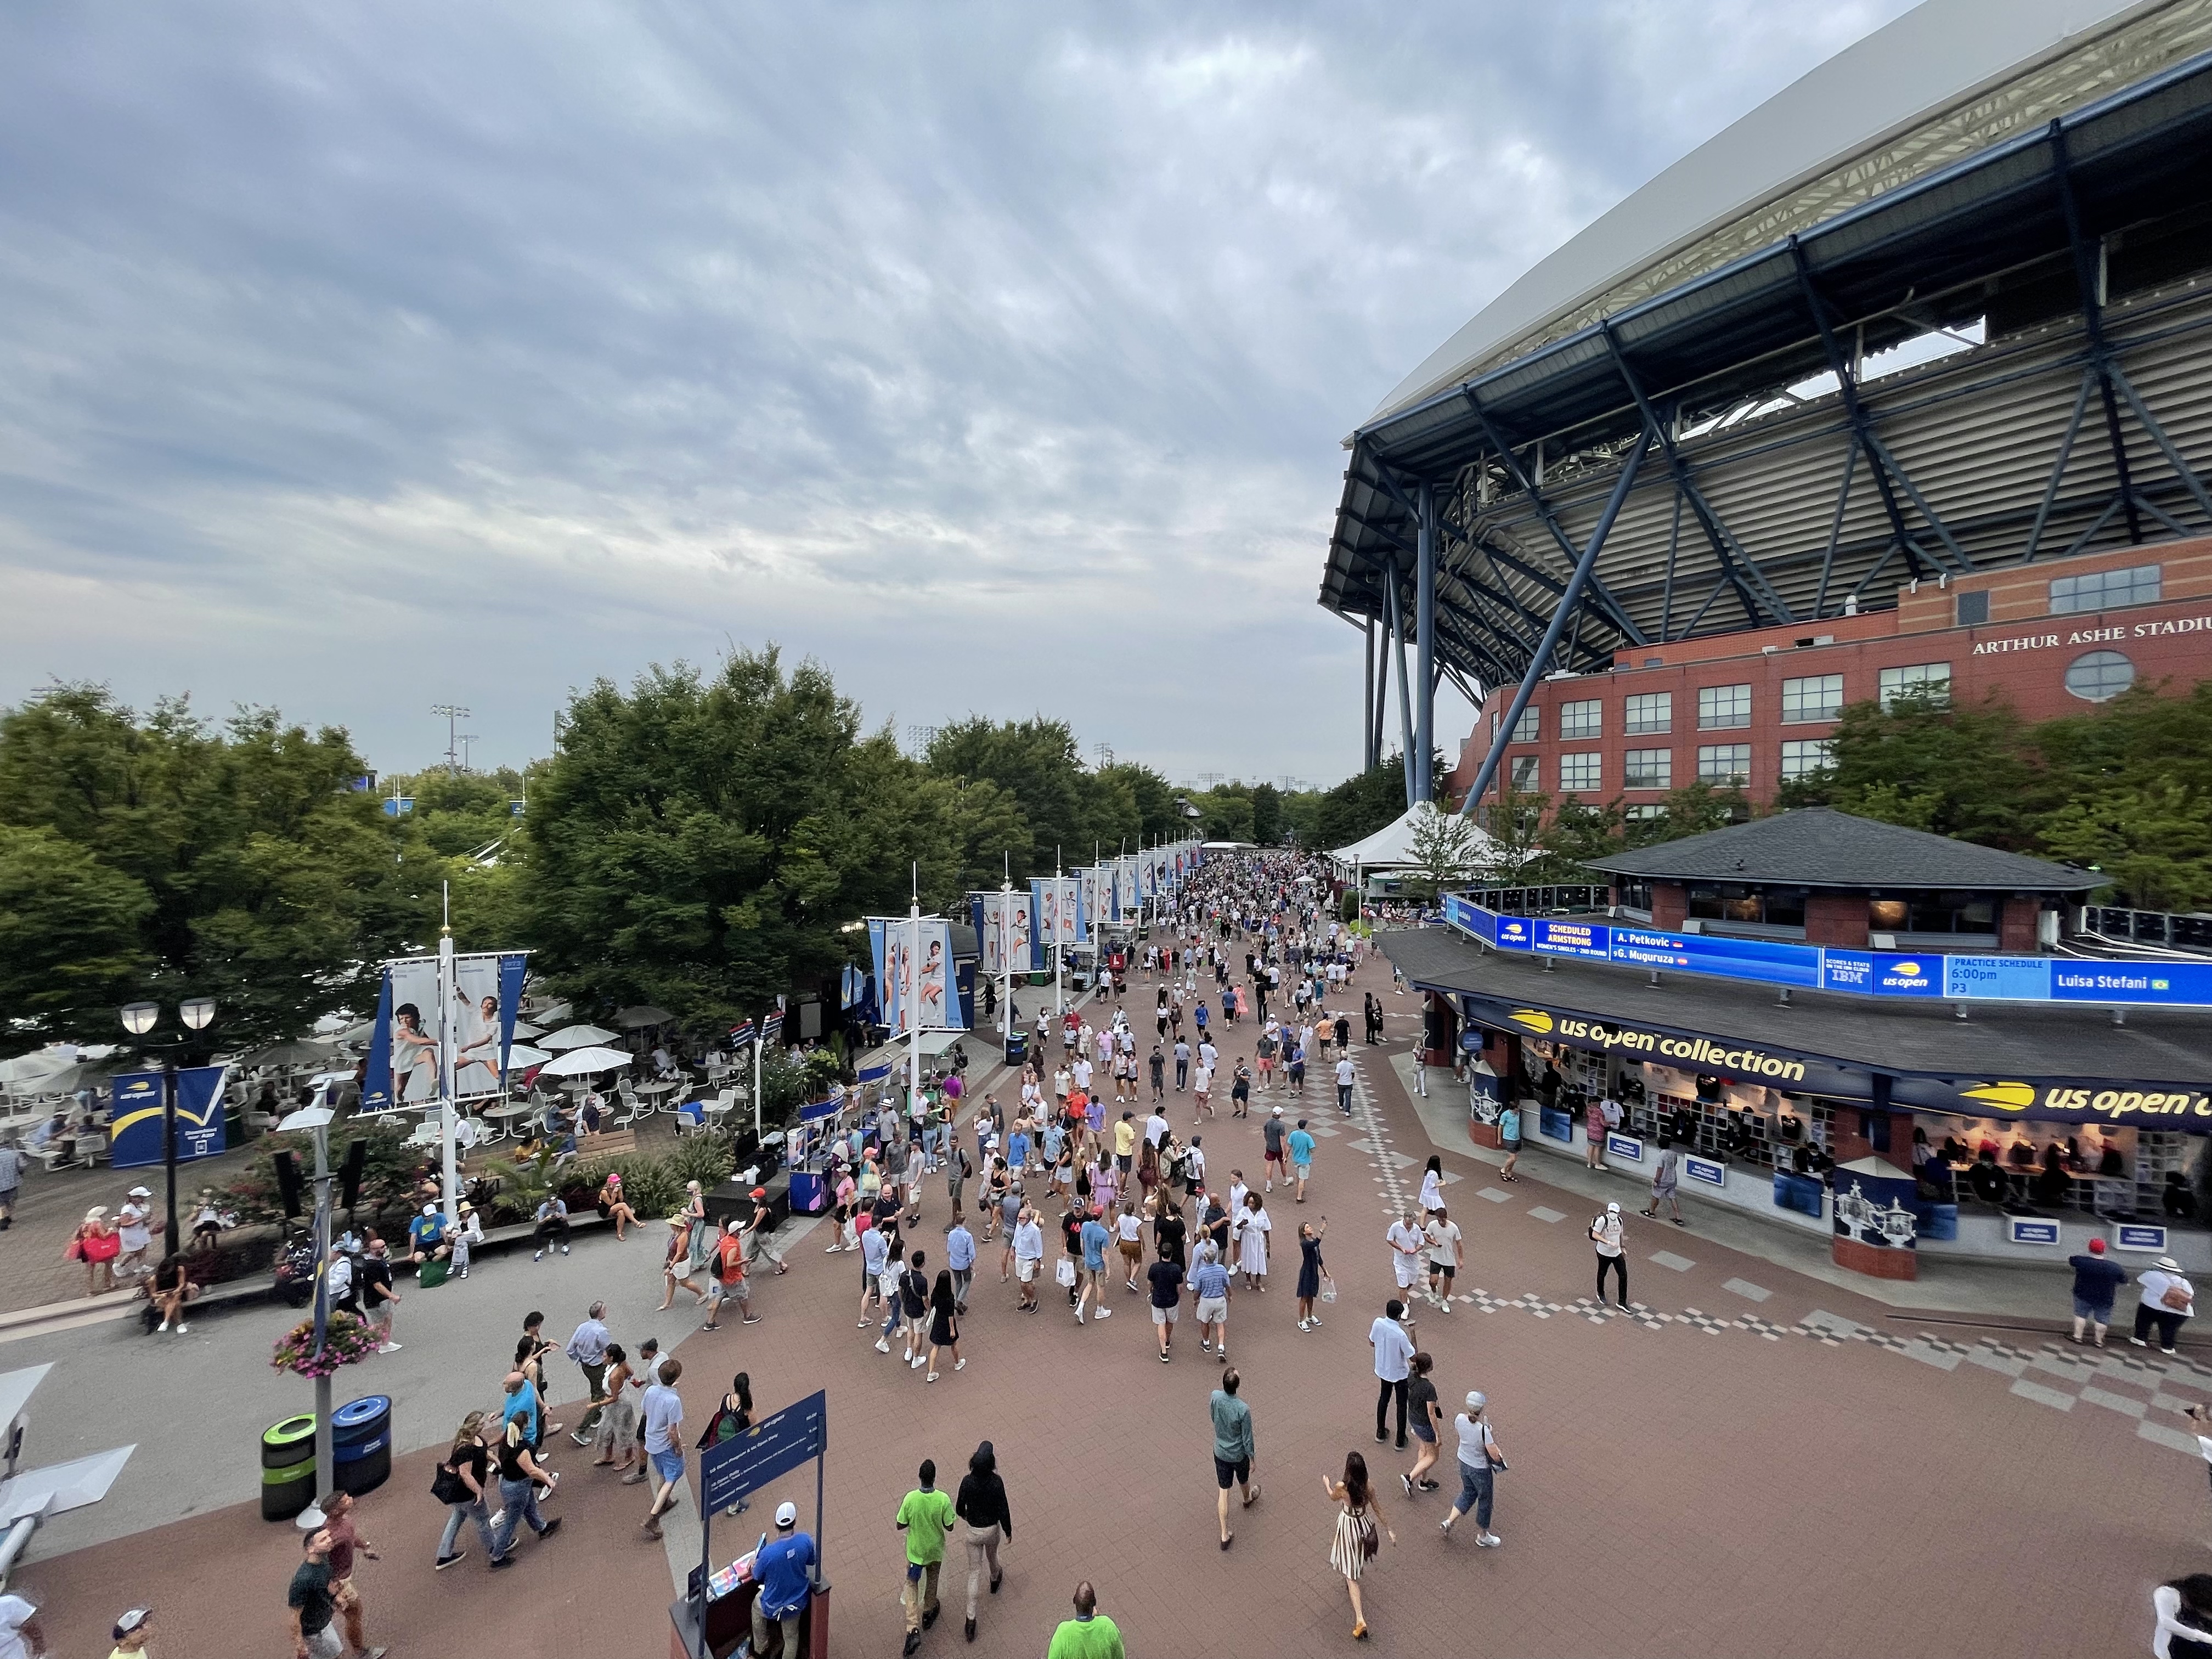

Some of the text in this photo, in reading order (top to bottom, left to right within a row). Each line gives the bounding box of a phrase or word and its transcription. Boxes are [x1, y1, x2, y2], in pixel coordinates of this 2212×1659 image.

[1973, 635, 2059, 654] ARTHUR
[2067, 627, 2125, 645] ASHE
[1549, 924, 1591, 936] SCHEDULED
[1548, 934, 1592, 946] ARMSTRONG
[1617, 933, 1669, 947] A. Petkovic
[1617, 949, 1627, 958] G.
[1629, 950, 1674, 964] Muguruza
[1955, 958, 2044, 968] PRACTICE SCHEDULE
[1832, 969, 1863, 984] IBM
[1951, 968, 1997, 981] 6:00pm
[1883, 978, 1928, 989] us open
[1951, 983, 1966, 993] P3
[2058, 974, 2147, 990] Luisa Stefani
[1560, 1019, 1588, 1037] us
[1590, 1025, 1655, 1051] open
[1660, 1038, 1805, 1082] collection
[2044, 1088, 2091, 1109] us
[2091, 1091, 2190, 1118] open
